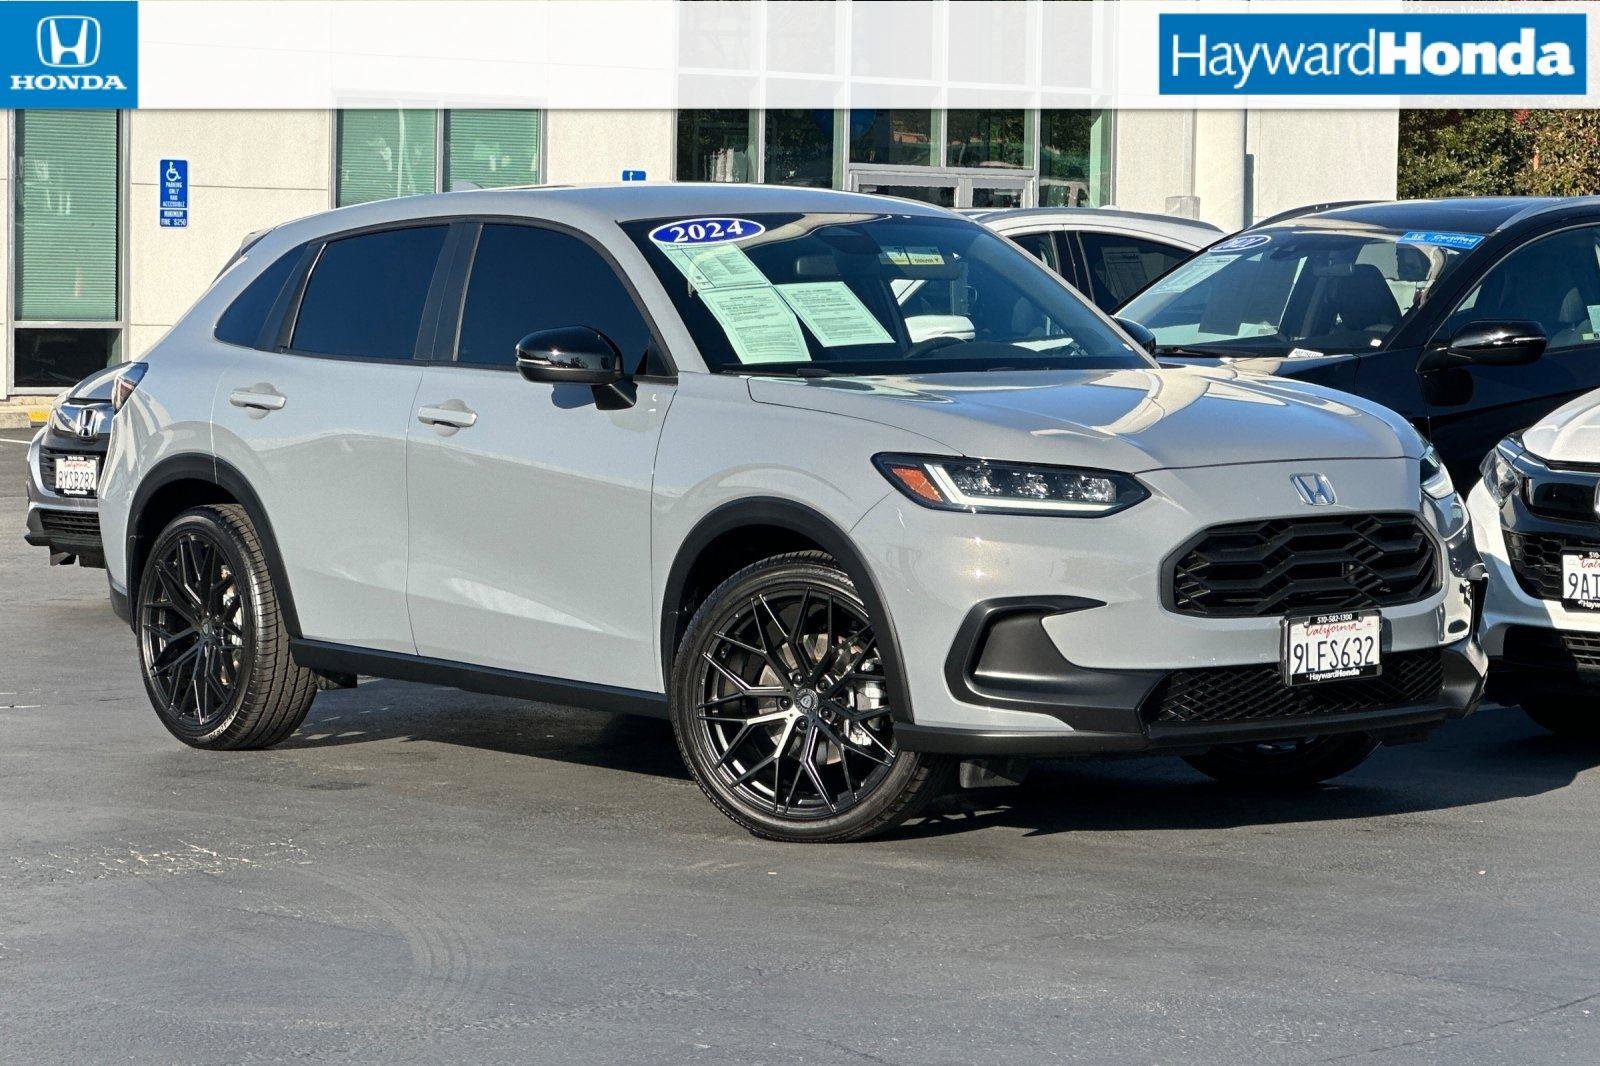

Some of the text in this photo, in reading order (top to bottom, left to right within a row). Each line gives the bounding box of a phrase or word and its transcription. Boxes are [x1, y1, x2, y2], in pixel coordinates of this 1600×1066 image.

[669, 220, 743, 243] 2024
[1306, 622, 1362, 638] California
[1293, 636, 1374, 674] 9LFS632
